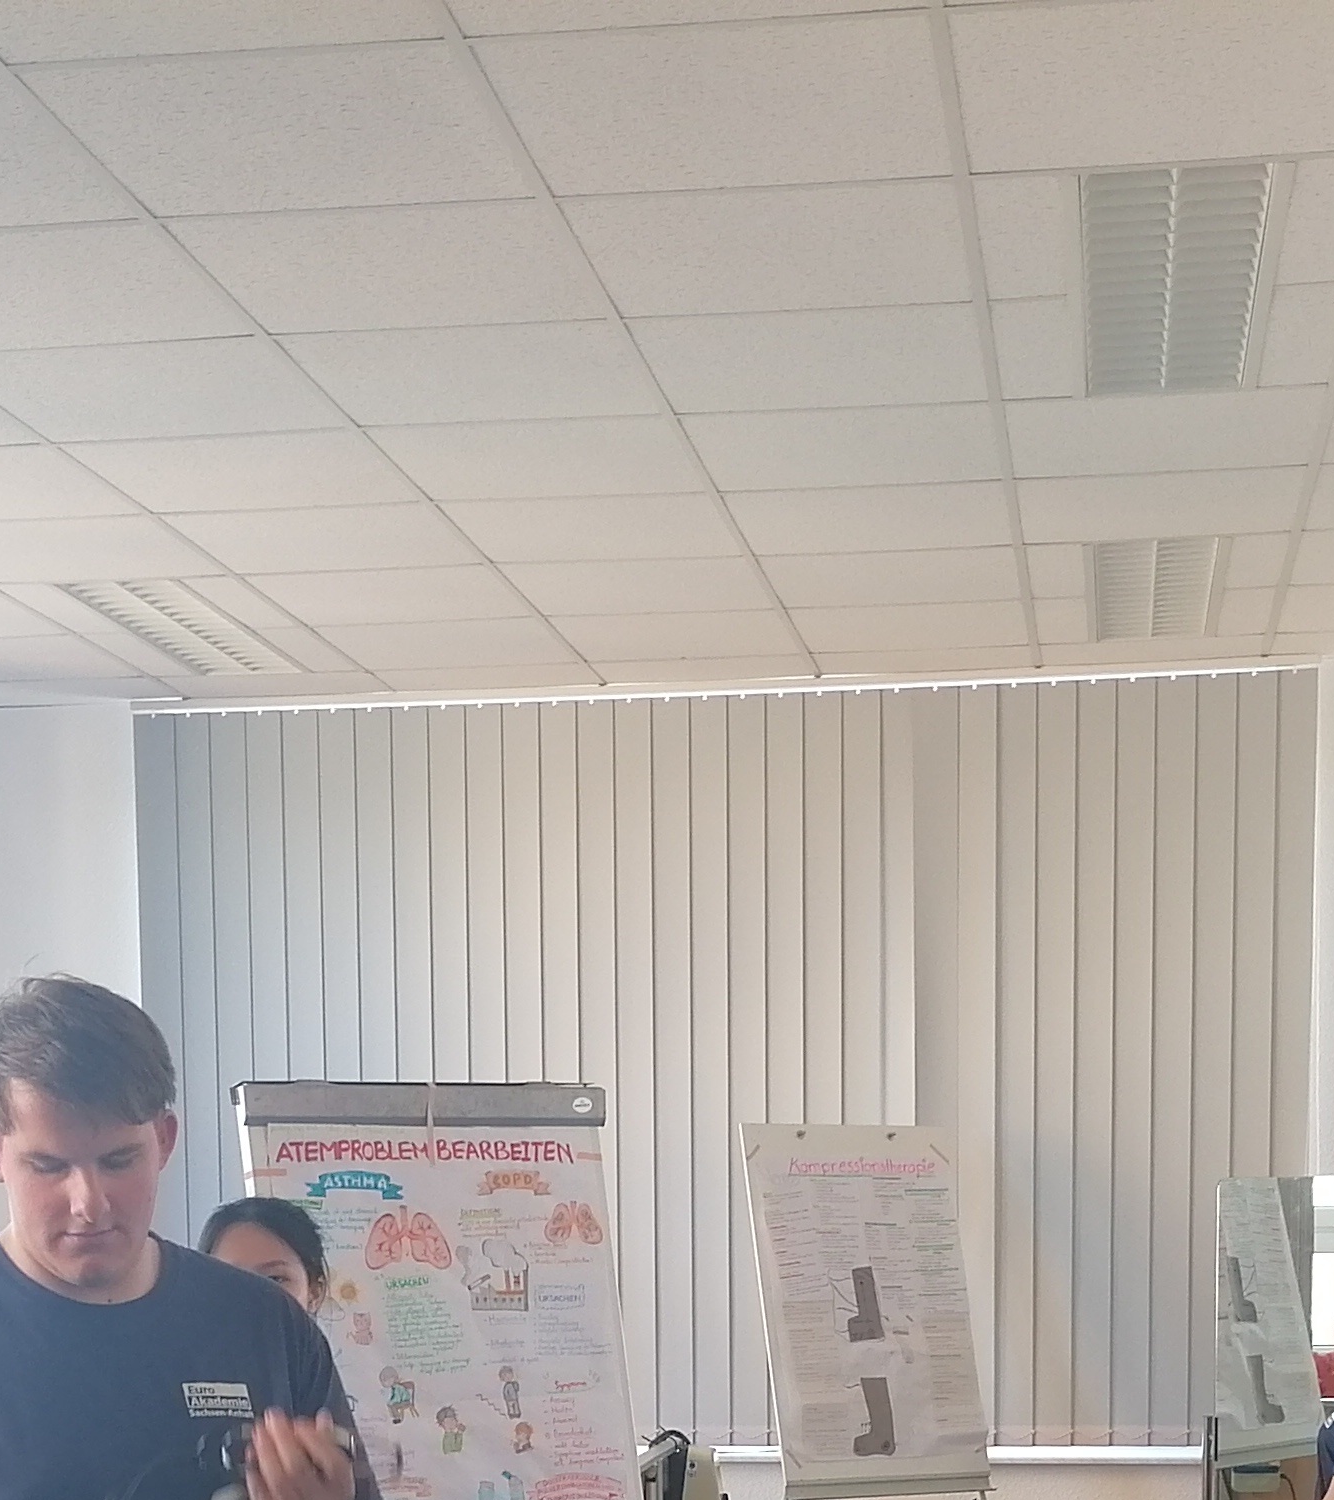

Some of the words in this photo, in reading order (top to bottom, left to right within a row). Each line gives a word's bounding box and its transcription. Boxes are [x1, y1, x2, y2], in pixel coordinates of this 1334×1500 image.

[275, 1139, 429, 1163] ATEMPROBLEM
[435, 1139, 575, 1164] BEARBEITEN
[323, 1172, 389, 1189] ASTHMA
[187, 1385, 215, 1394] Euro
[190, 1396, 250, 1408] Akademie
